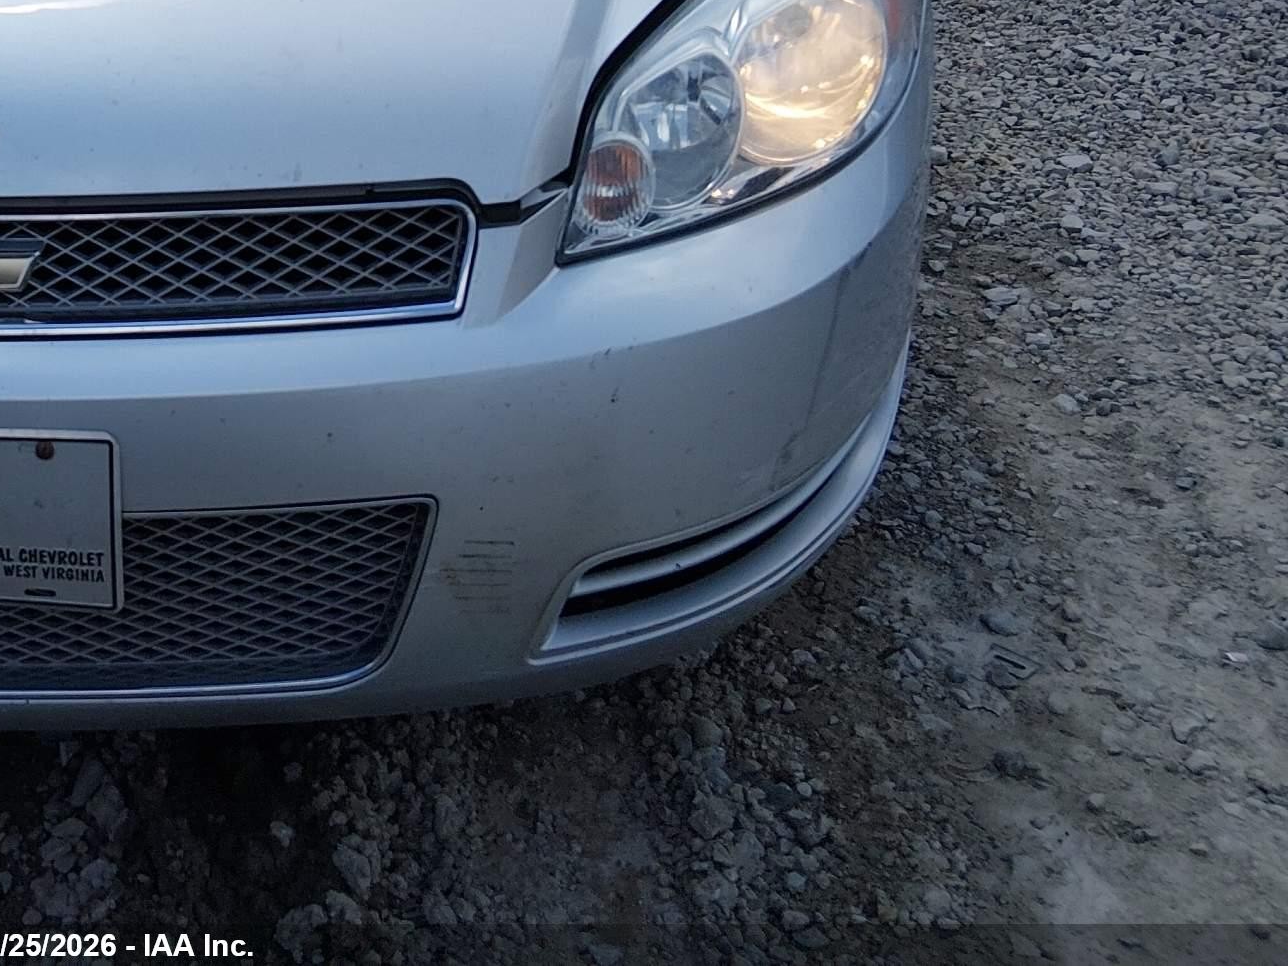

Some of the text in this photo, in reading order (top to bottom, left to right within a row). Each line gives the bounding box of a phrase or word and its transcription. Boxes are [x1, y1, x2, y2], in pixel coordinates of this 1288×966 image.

[18, 548, 105, 567] CHEVROLET
[3, 565, 40, 579] WEST
[42, 567, 105, 583] VIRGINIA
